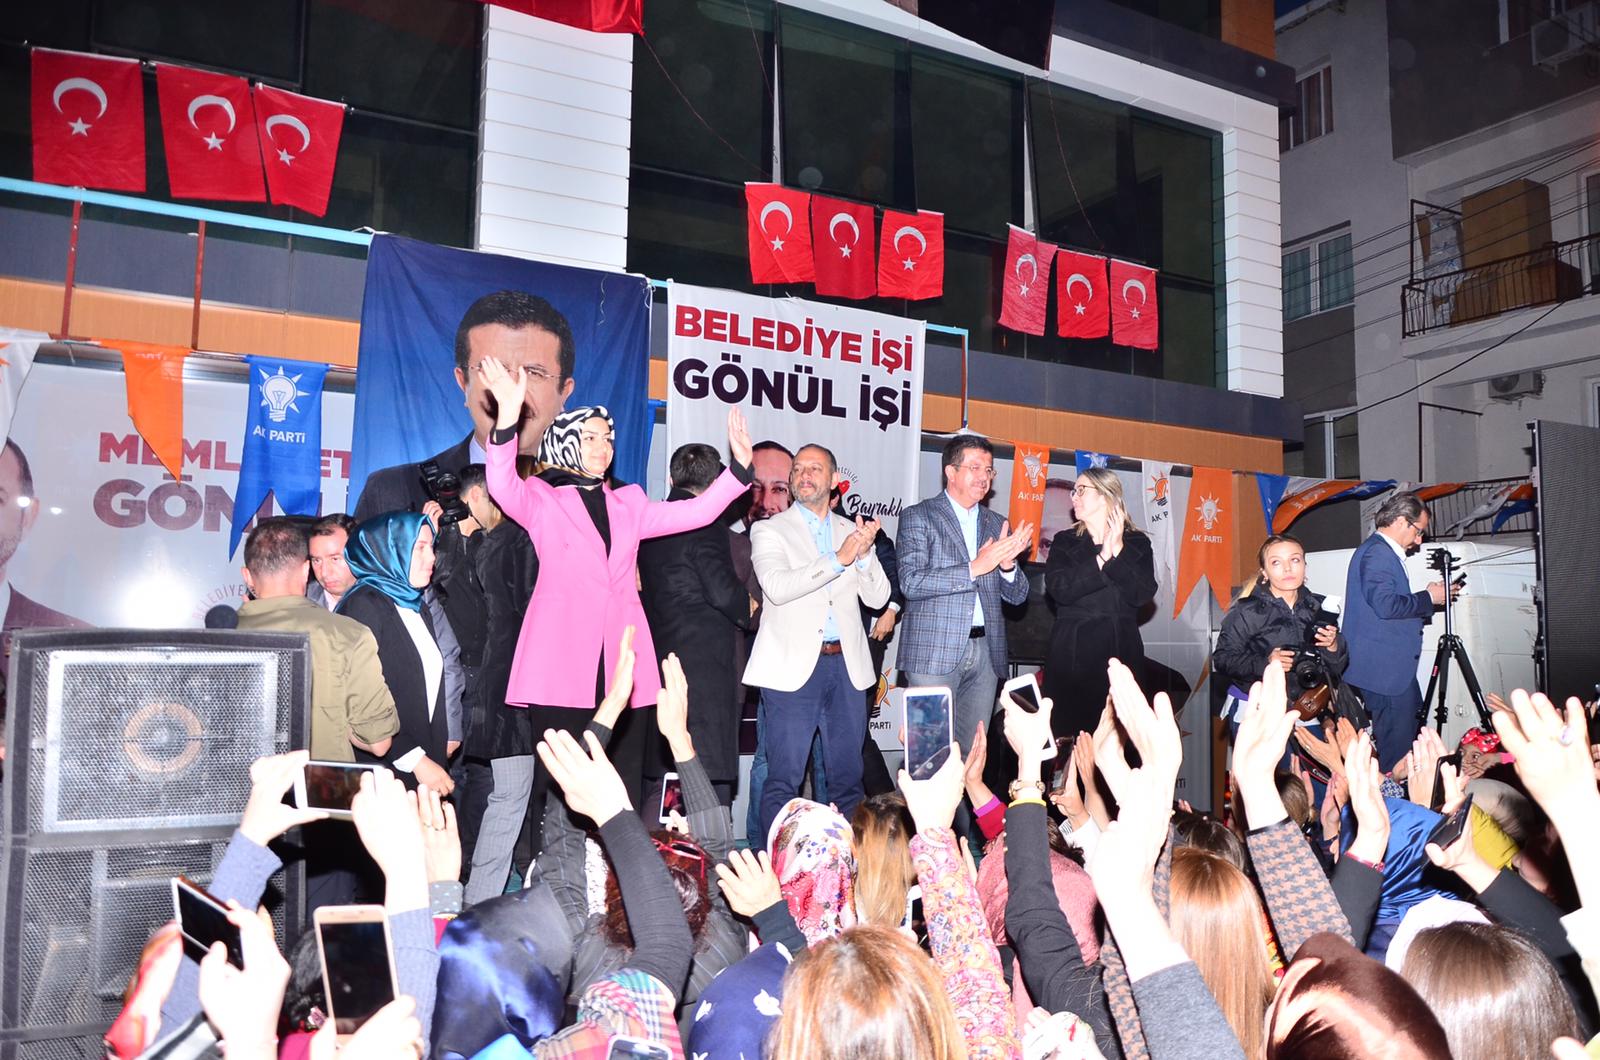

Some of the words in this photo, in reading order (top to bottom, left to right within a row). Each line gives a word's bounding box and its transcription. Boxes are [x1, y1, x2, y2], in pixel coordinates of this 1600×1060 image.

[675, 305, 862, 363] BELEDİYE
[872, 329, 912, 374] İŞİ
[673, 352, 847, 418] GÖNÜL
[859, 374, 911, 432] İŞİ
[1191, 534, 1203, 543] AK
